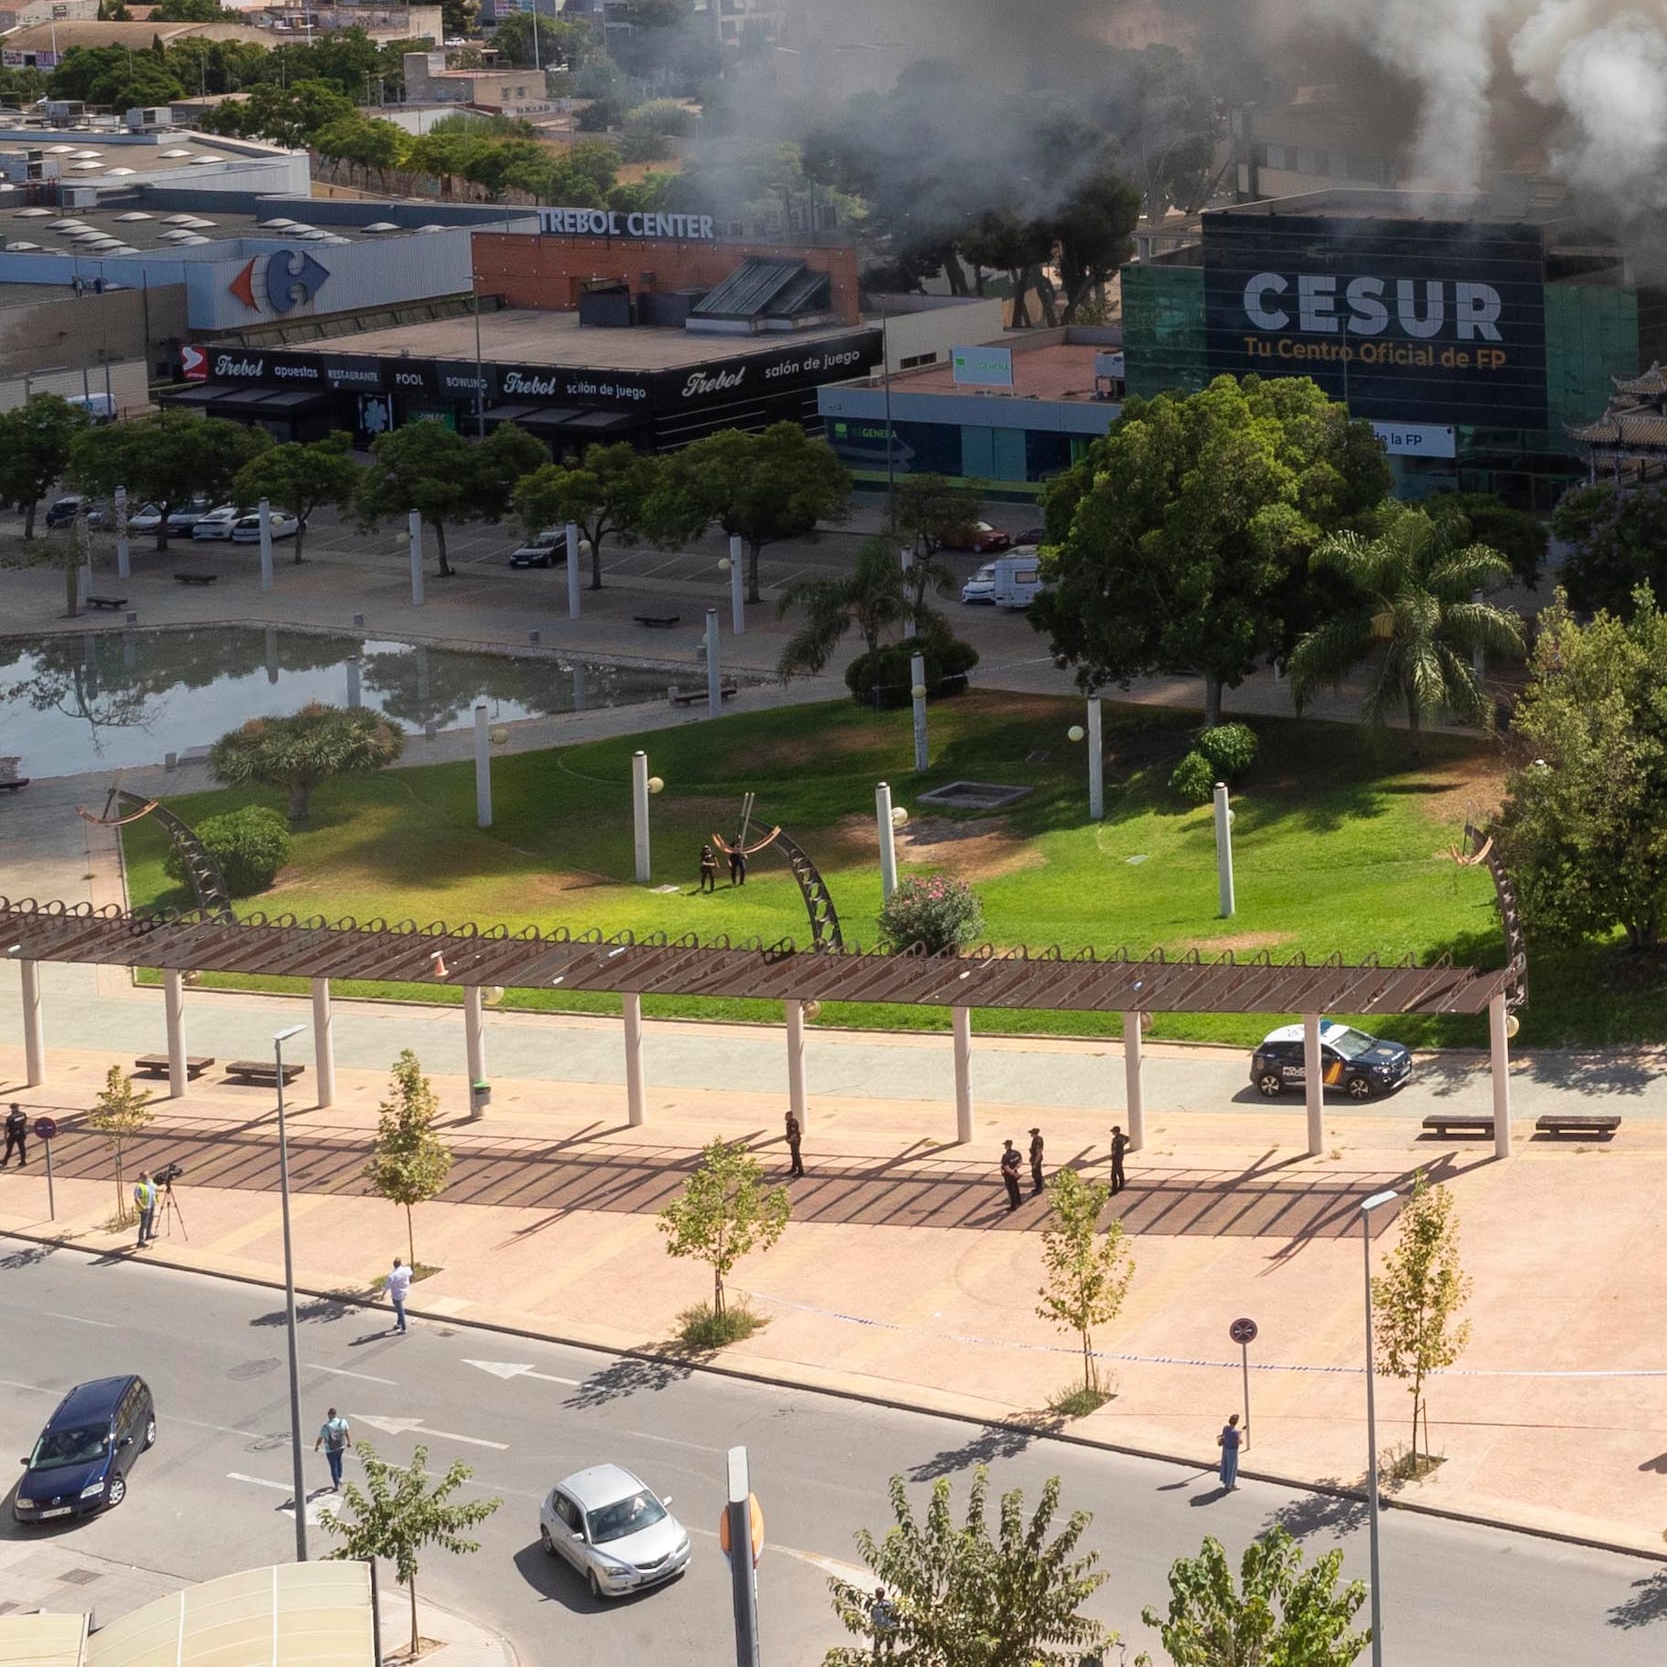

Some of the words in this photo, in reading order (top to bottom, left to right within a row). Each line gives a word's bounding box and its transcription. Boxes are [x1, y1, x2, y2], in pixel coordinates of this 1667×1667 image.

[537, 208, 621, 235] TREBOL
[627, 212, 714, 238] CENTER
[1243, 272, 1503, 341] CESUR
[214, 354, 263, 378] Trebol
[274, 365, 319, 379] apuestas
[1244, 337, 1271, 357] Tu
[1278, 337, 1353, 361] Centro
[1359, 342, 1434, 366] Oficial
[1441, 346, 1469, 368] de
[1477, 349, 1506, 370] FP
[327, 369, 379, 383] RESTAURANTE
[395, 373, 424, 385] POOL
[446, 376, 488, 389] BOWLING
[503, 371, 556, 396] Trebol
[600, 383, 613, 395] de
[615, 386, 647, 399] juego
[682, 366, 746, 397] Trebol
[765, 359, 799, 378] salón
[803, 356, 820, 371] de
[823, 348, 860, 372] juego
[1391, 432, 1402, 445] la
[1406, 434, 1422, 446] FP
